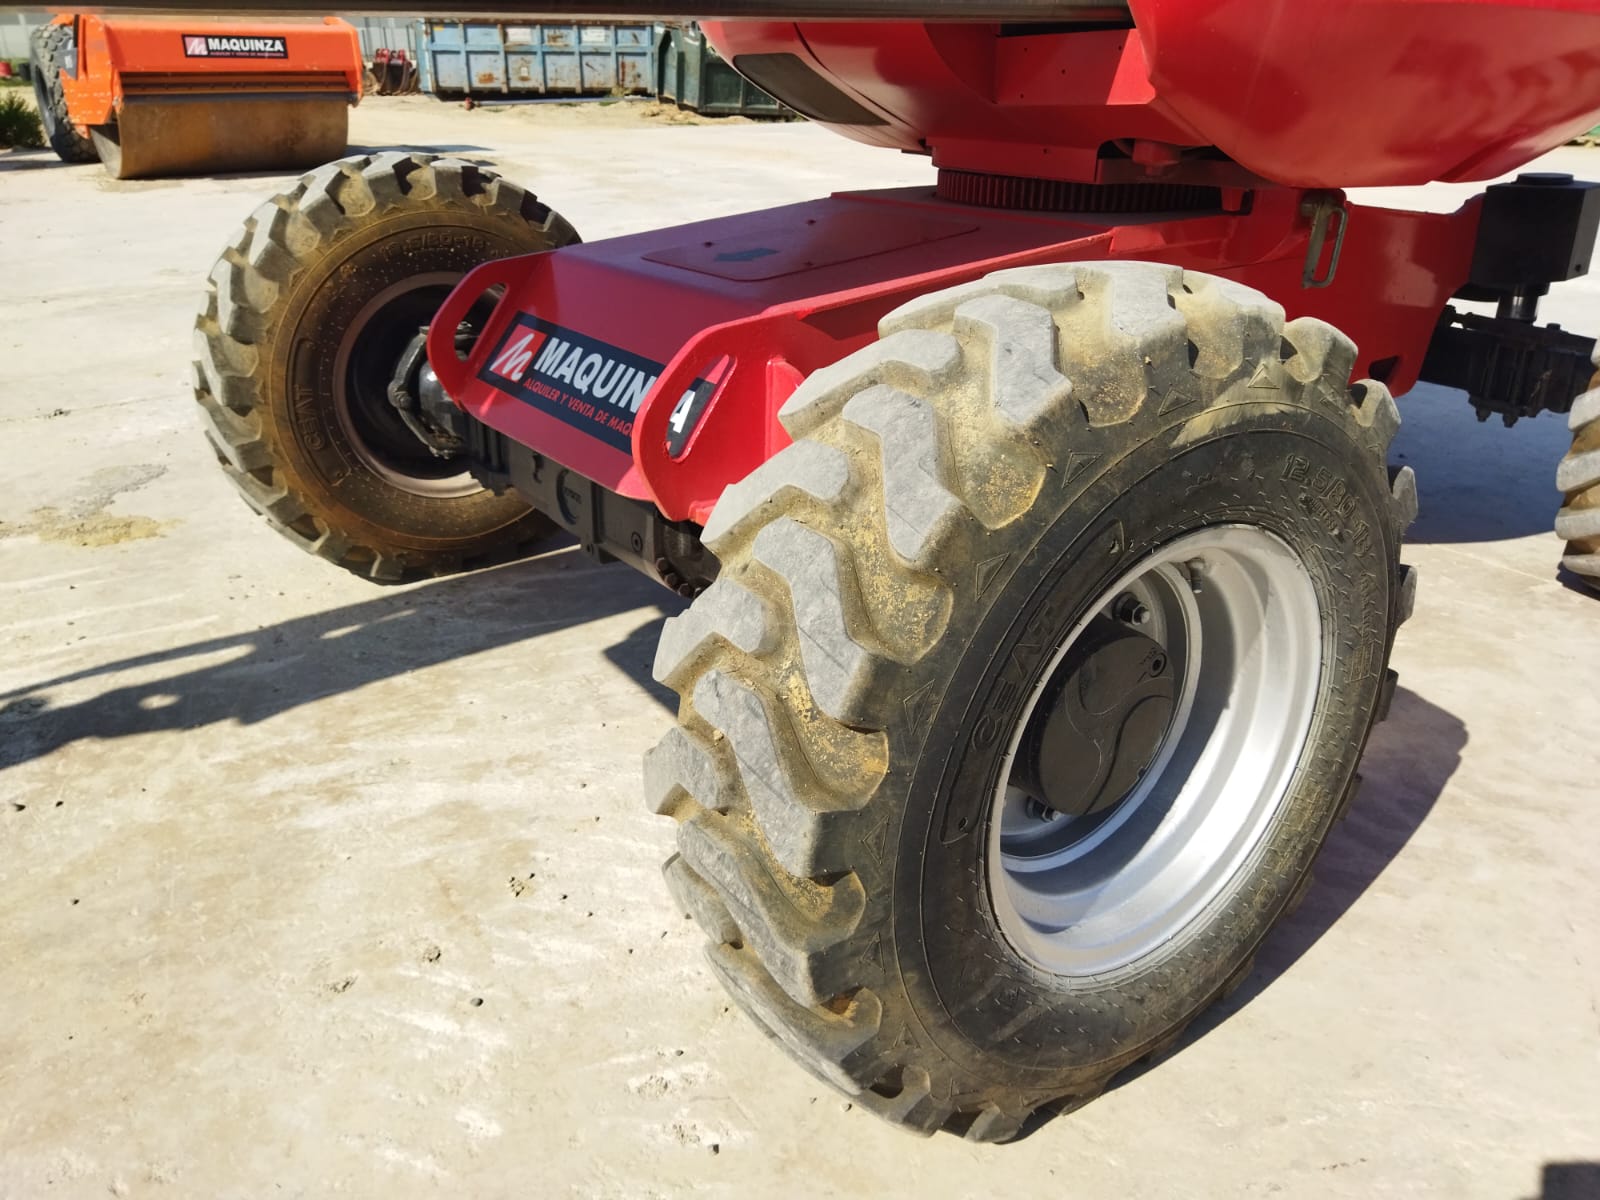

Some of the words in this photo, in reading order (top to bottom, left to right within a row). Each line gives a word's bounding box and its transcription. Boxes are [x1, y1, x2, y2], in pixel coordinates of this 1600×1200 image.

[208, 38, 284, 51] MAQUINZA
[523, 378, 561, 400] ALQUILER
[560, 394, 569, 406] Y
[567, 397, 595, 418] VENTA
[594, 409, 609, 425] DE
